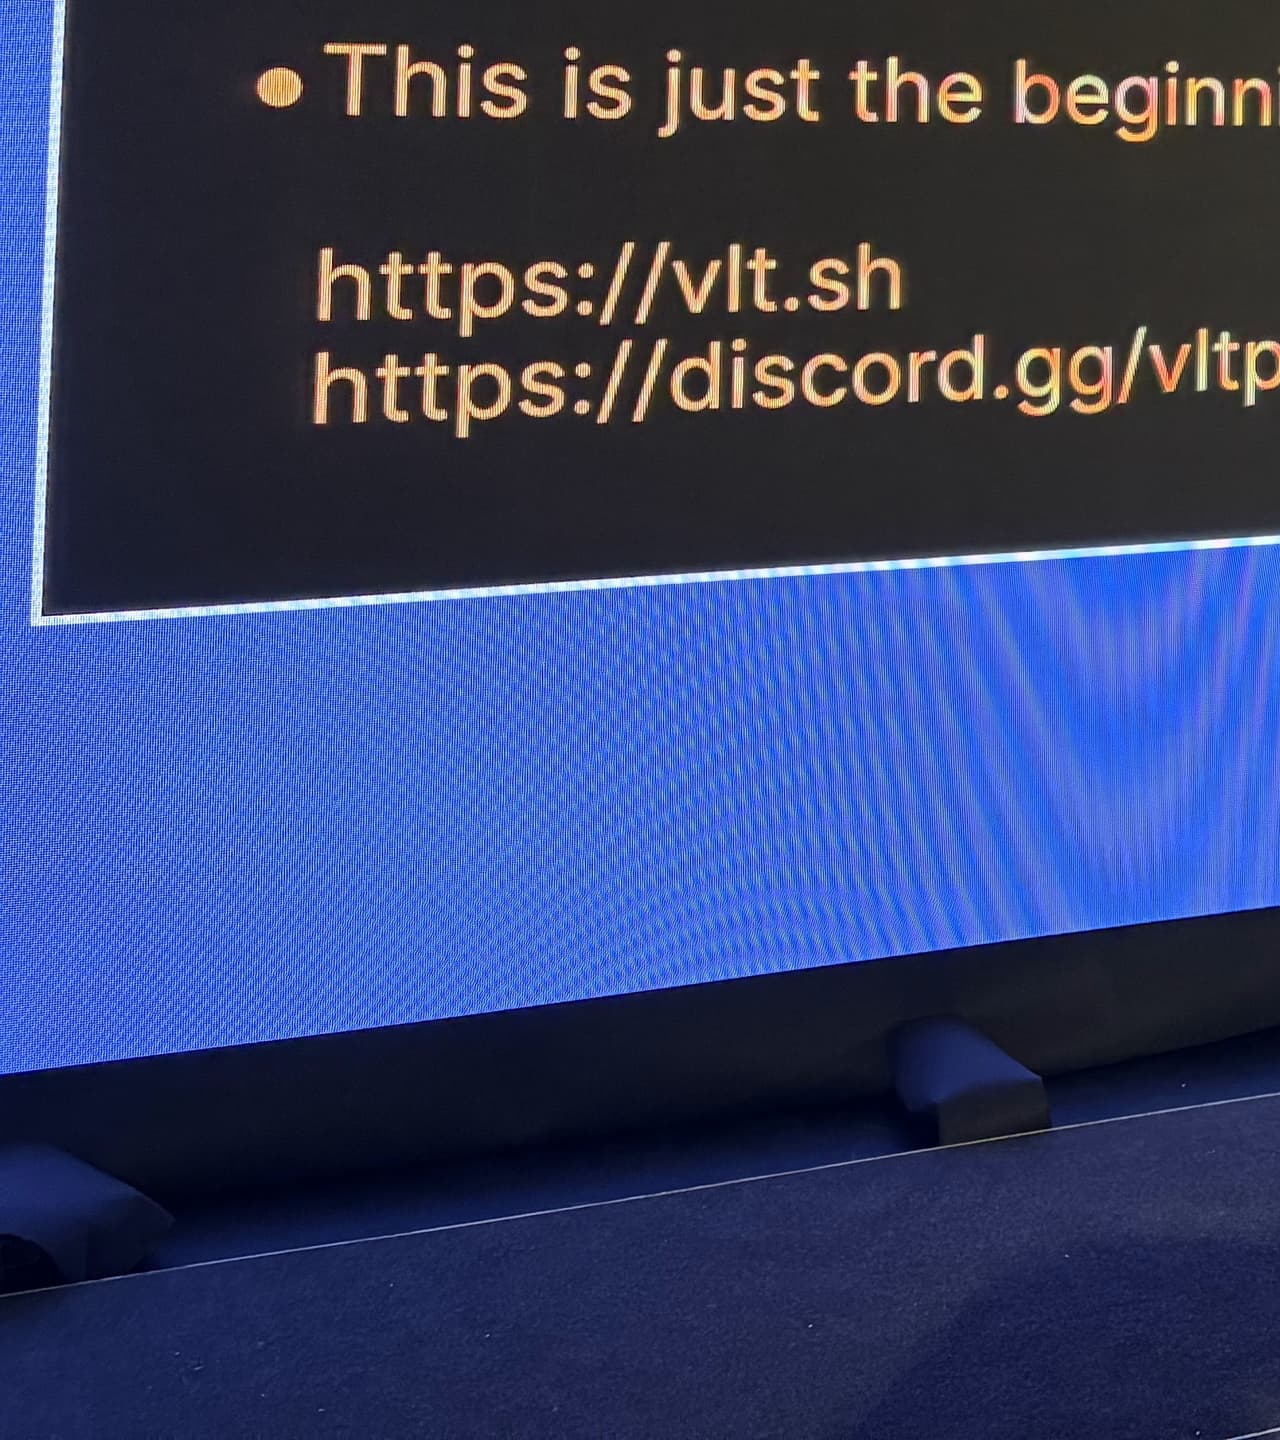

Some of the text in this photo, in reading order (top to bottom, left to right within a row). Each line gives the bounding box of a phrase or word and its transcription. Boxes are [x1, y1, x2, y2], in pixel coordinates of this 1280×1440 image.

[323, 42, 528, 119] This
[563, 46, 632, 120] is
[657, 48, 820, 138] just
[848, 55, 983, 124] the
[317, 241, 901, 338] https://vlt.sh
